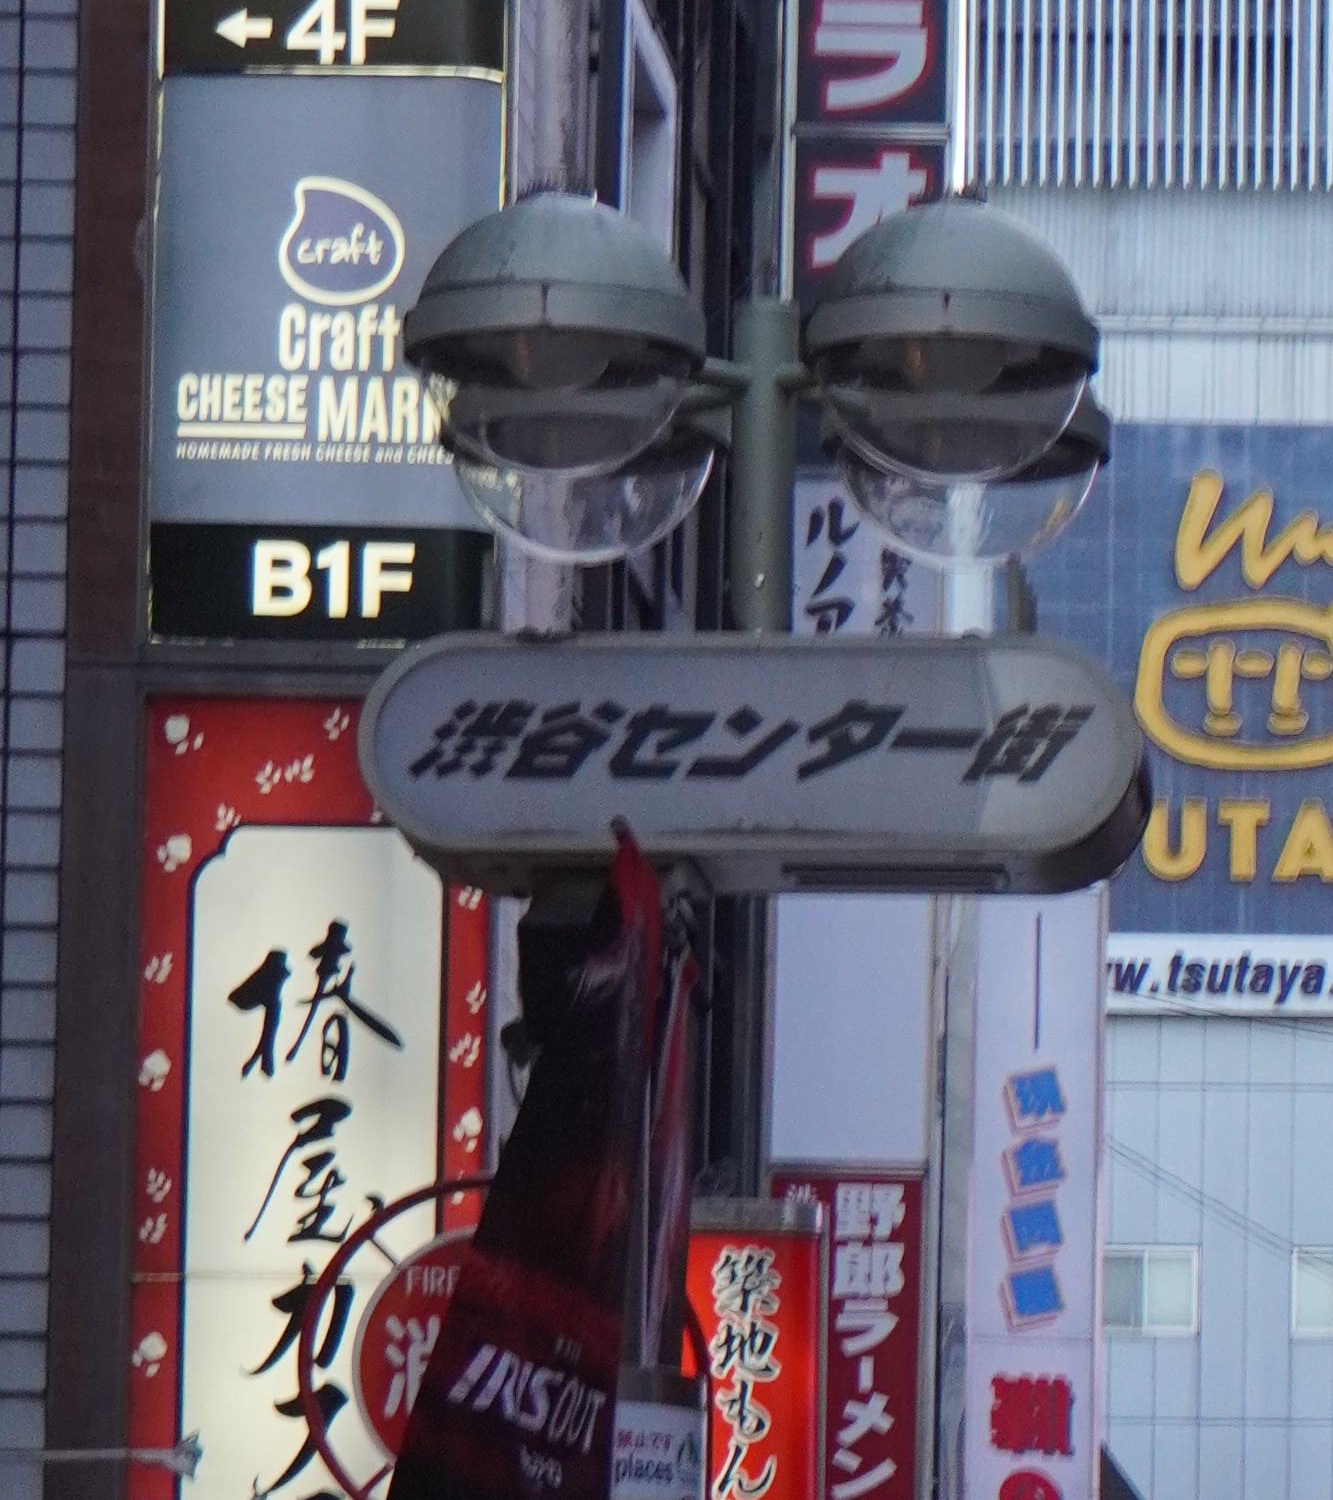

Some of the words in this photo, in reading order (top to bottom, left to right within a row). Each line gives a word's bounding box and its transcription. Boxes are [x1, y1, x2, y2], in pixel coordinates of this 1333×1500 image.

[297, 228, 384, 268] craft
[279, 304, 401, 372] Craft
[177, 373, 308, 423] CHEESE
[253, 539, 416, 619] B1F
[409, 699, 1096, 785] 渋谷センター街
